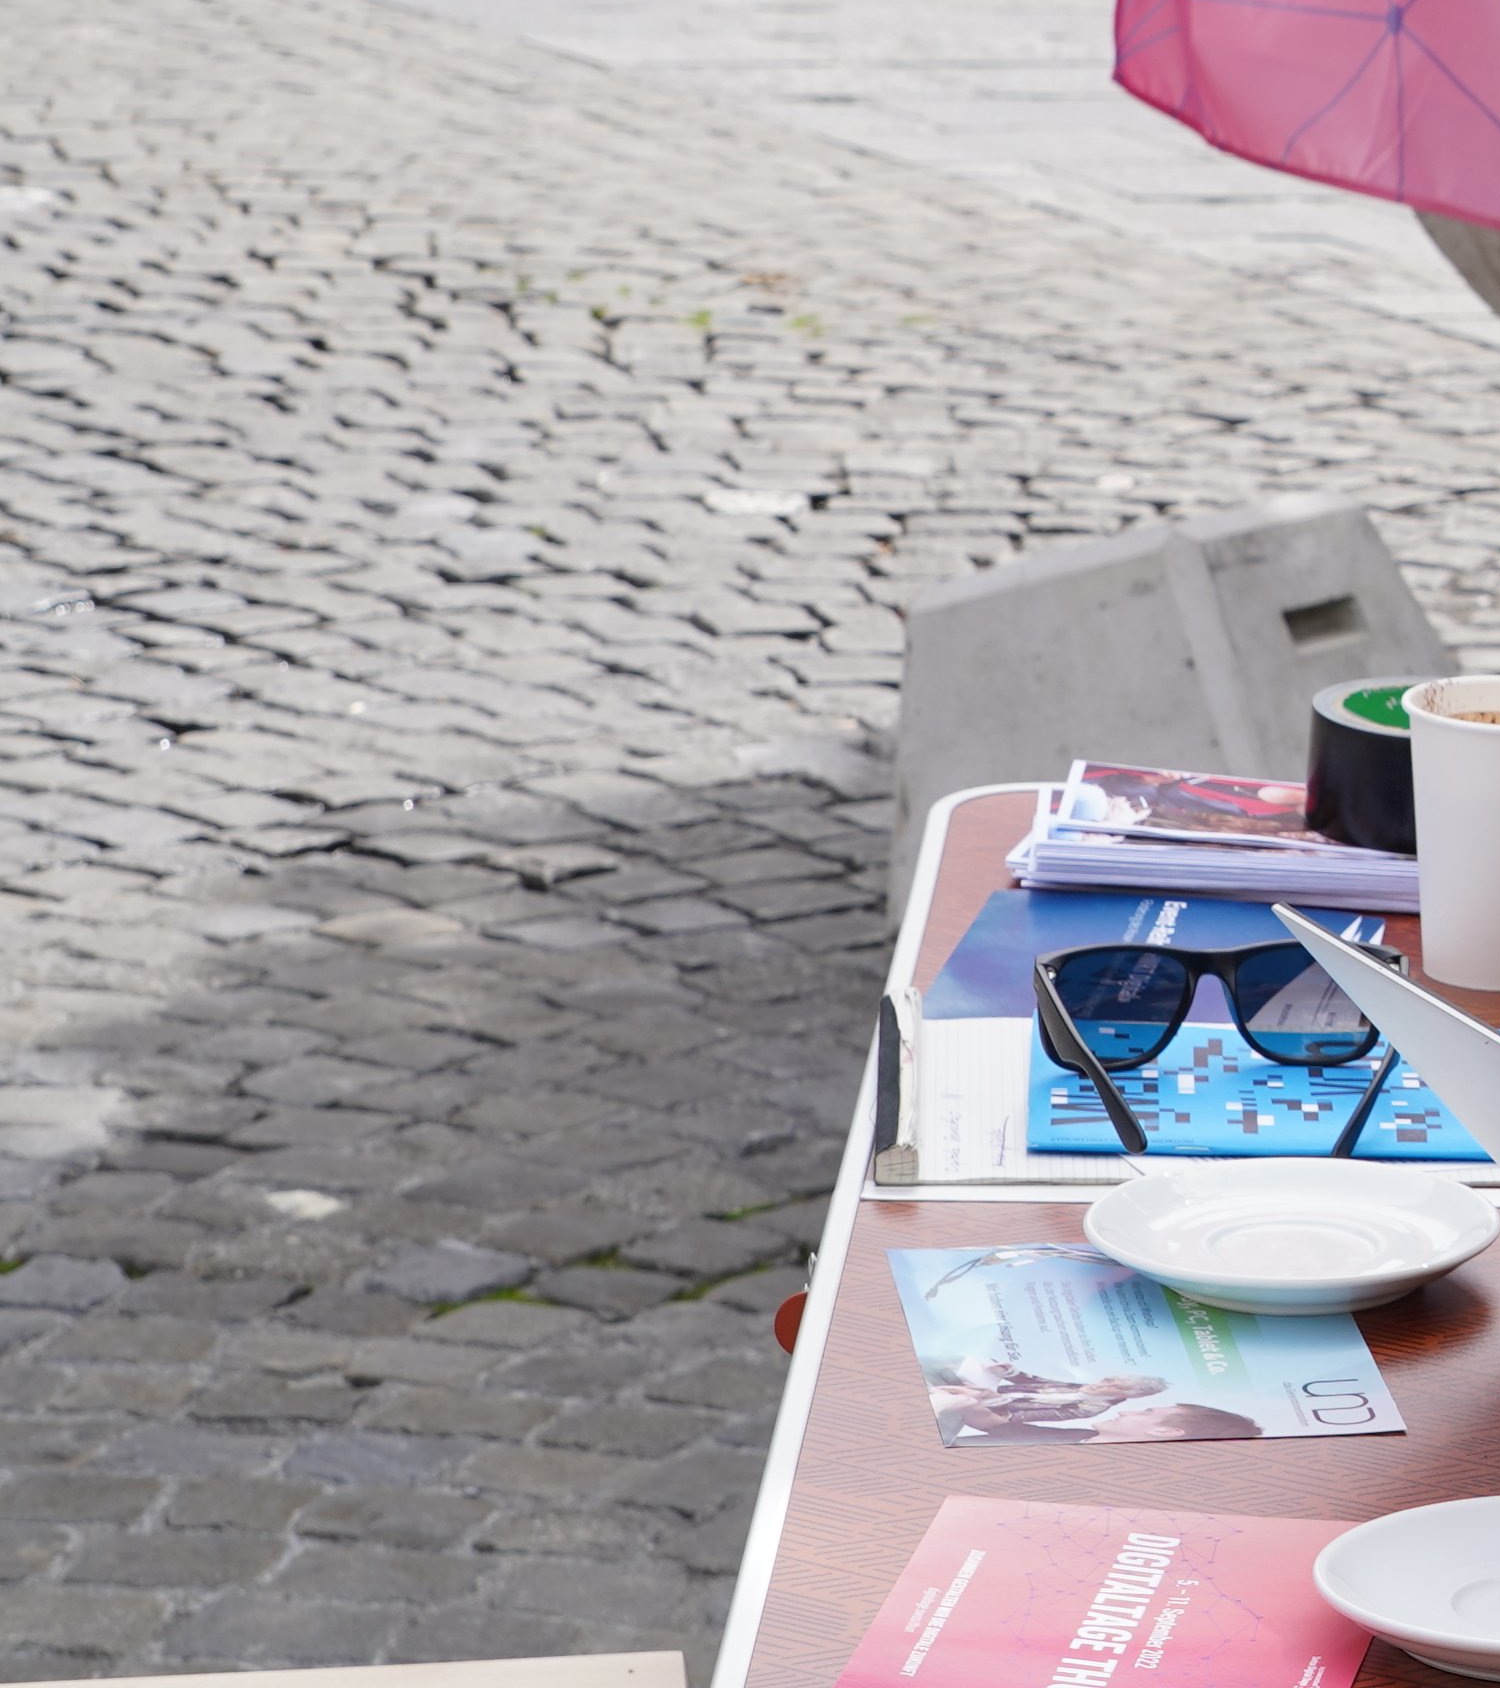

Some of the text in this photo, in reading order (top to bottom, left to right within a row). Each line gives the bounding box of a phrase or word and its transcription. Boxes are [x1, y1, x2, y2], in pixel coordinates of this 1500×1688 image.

[1190, 1326, 1218, 1352] Tablet
[938, 1577, 970, 1606] GESTALTEN
[1070, 1532, 1180, 1654] DIGITALTAGE
[1175, 1579, 1200, 1587] 5.
[1165, 1596, 1191, 1606] 11.
[913, 1626, 941, 1651] DIGITALE
[1144, 1608, 1184, 1648] September
[899, 1650, 927, 1677] ZUKUNFT
[1134, 1649, 1163, 1669] 2022
